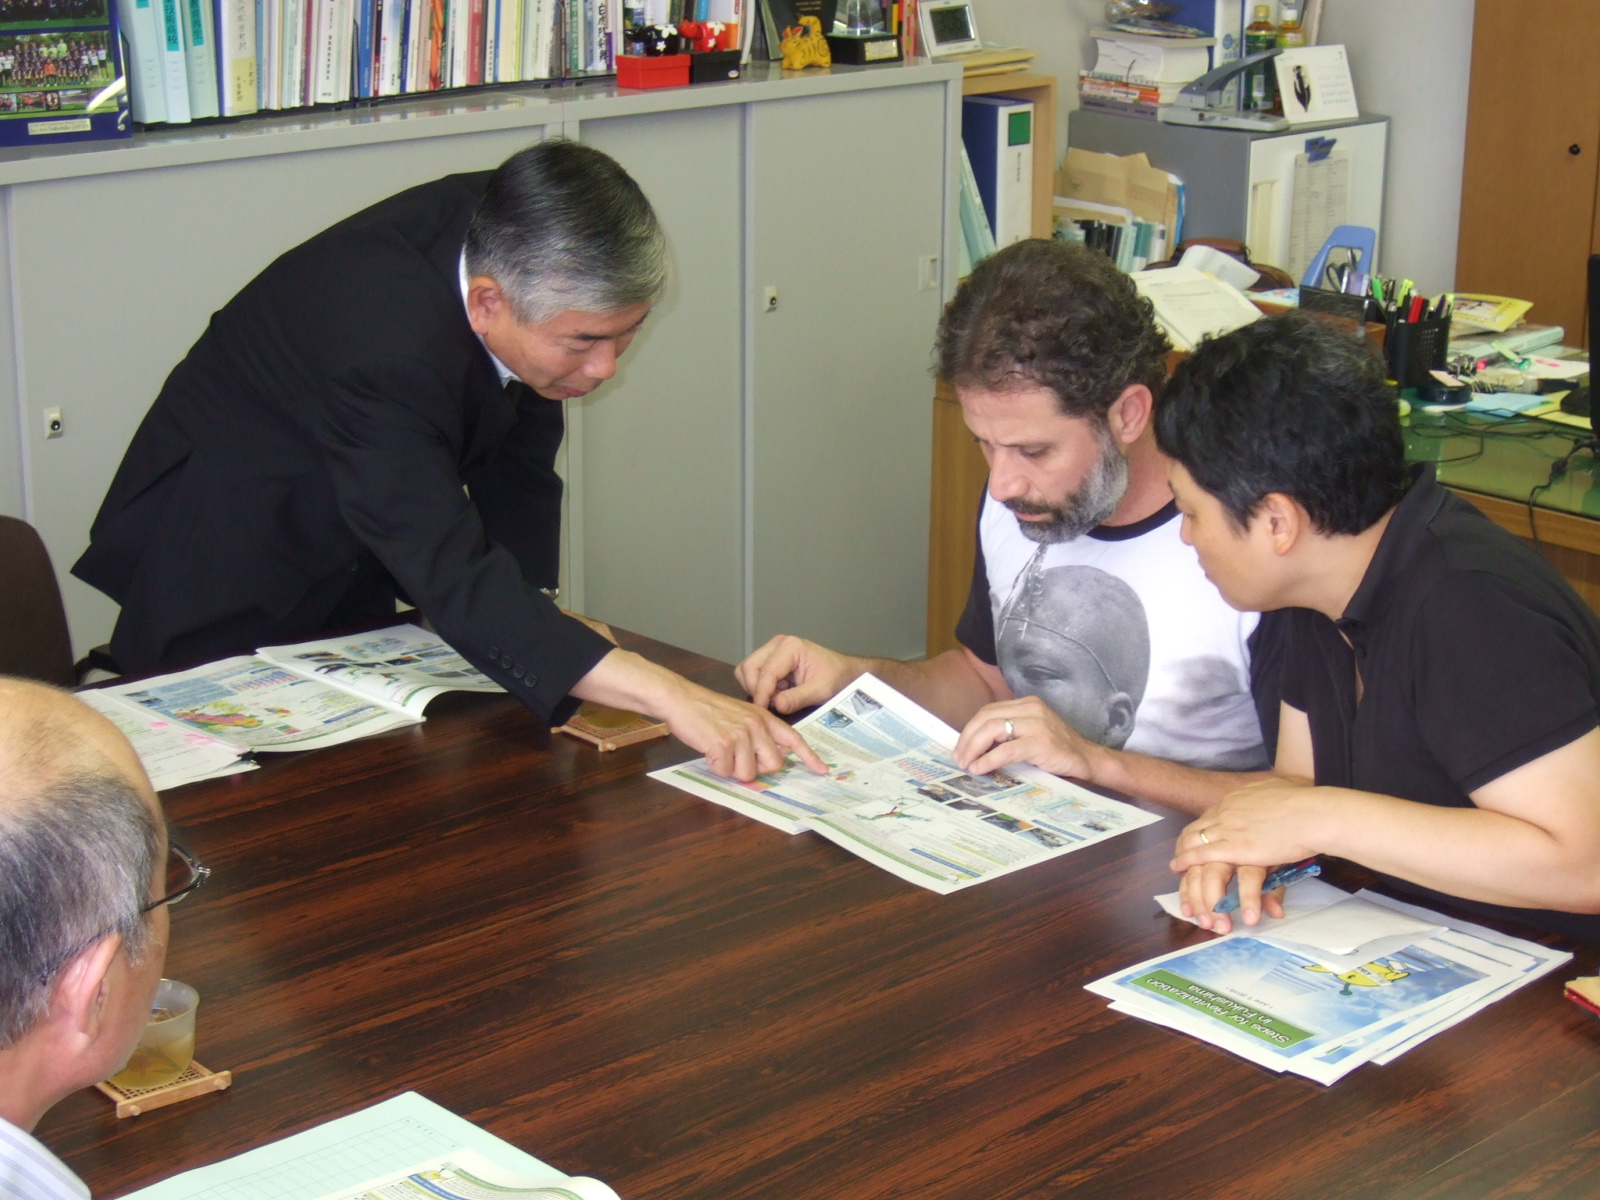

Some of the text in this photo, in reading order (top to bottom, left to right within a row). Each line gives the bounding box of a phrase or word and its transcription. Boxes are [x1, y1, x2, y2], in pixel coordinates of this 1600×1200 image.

[1146, 978, 1290, 1043] Steps for Revitalization
[1187, 984, 1273, 1025] in Fukushima
